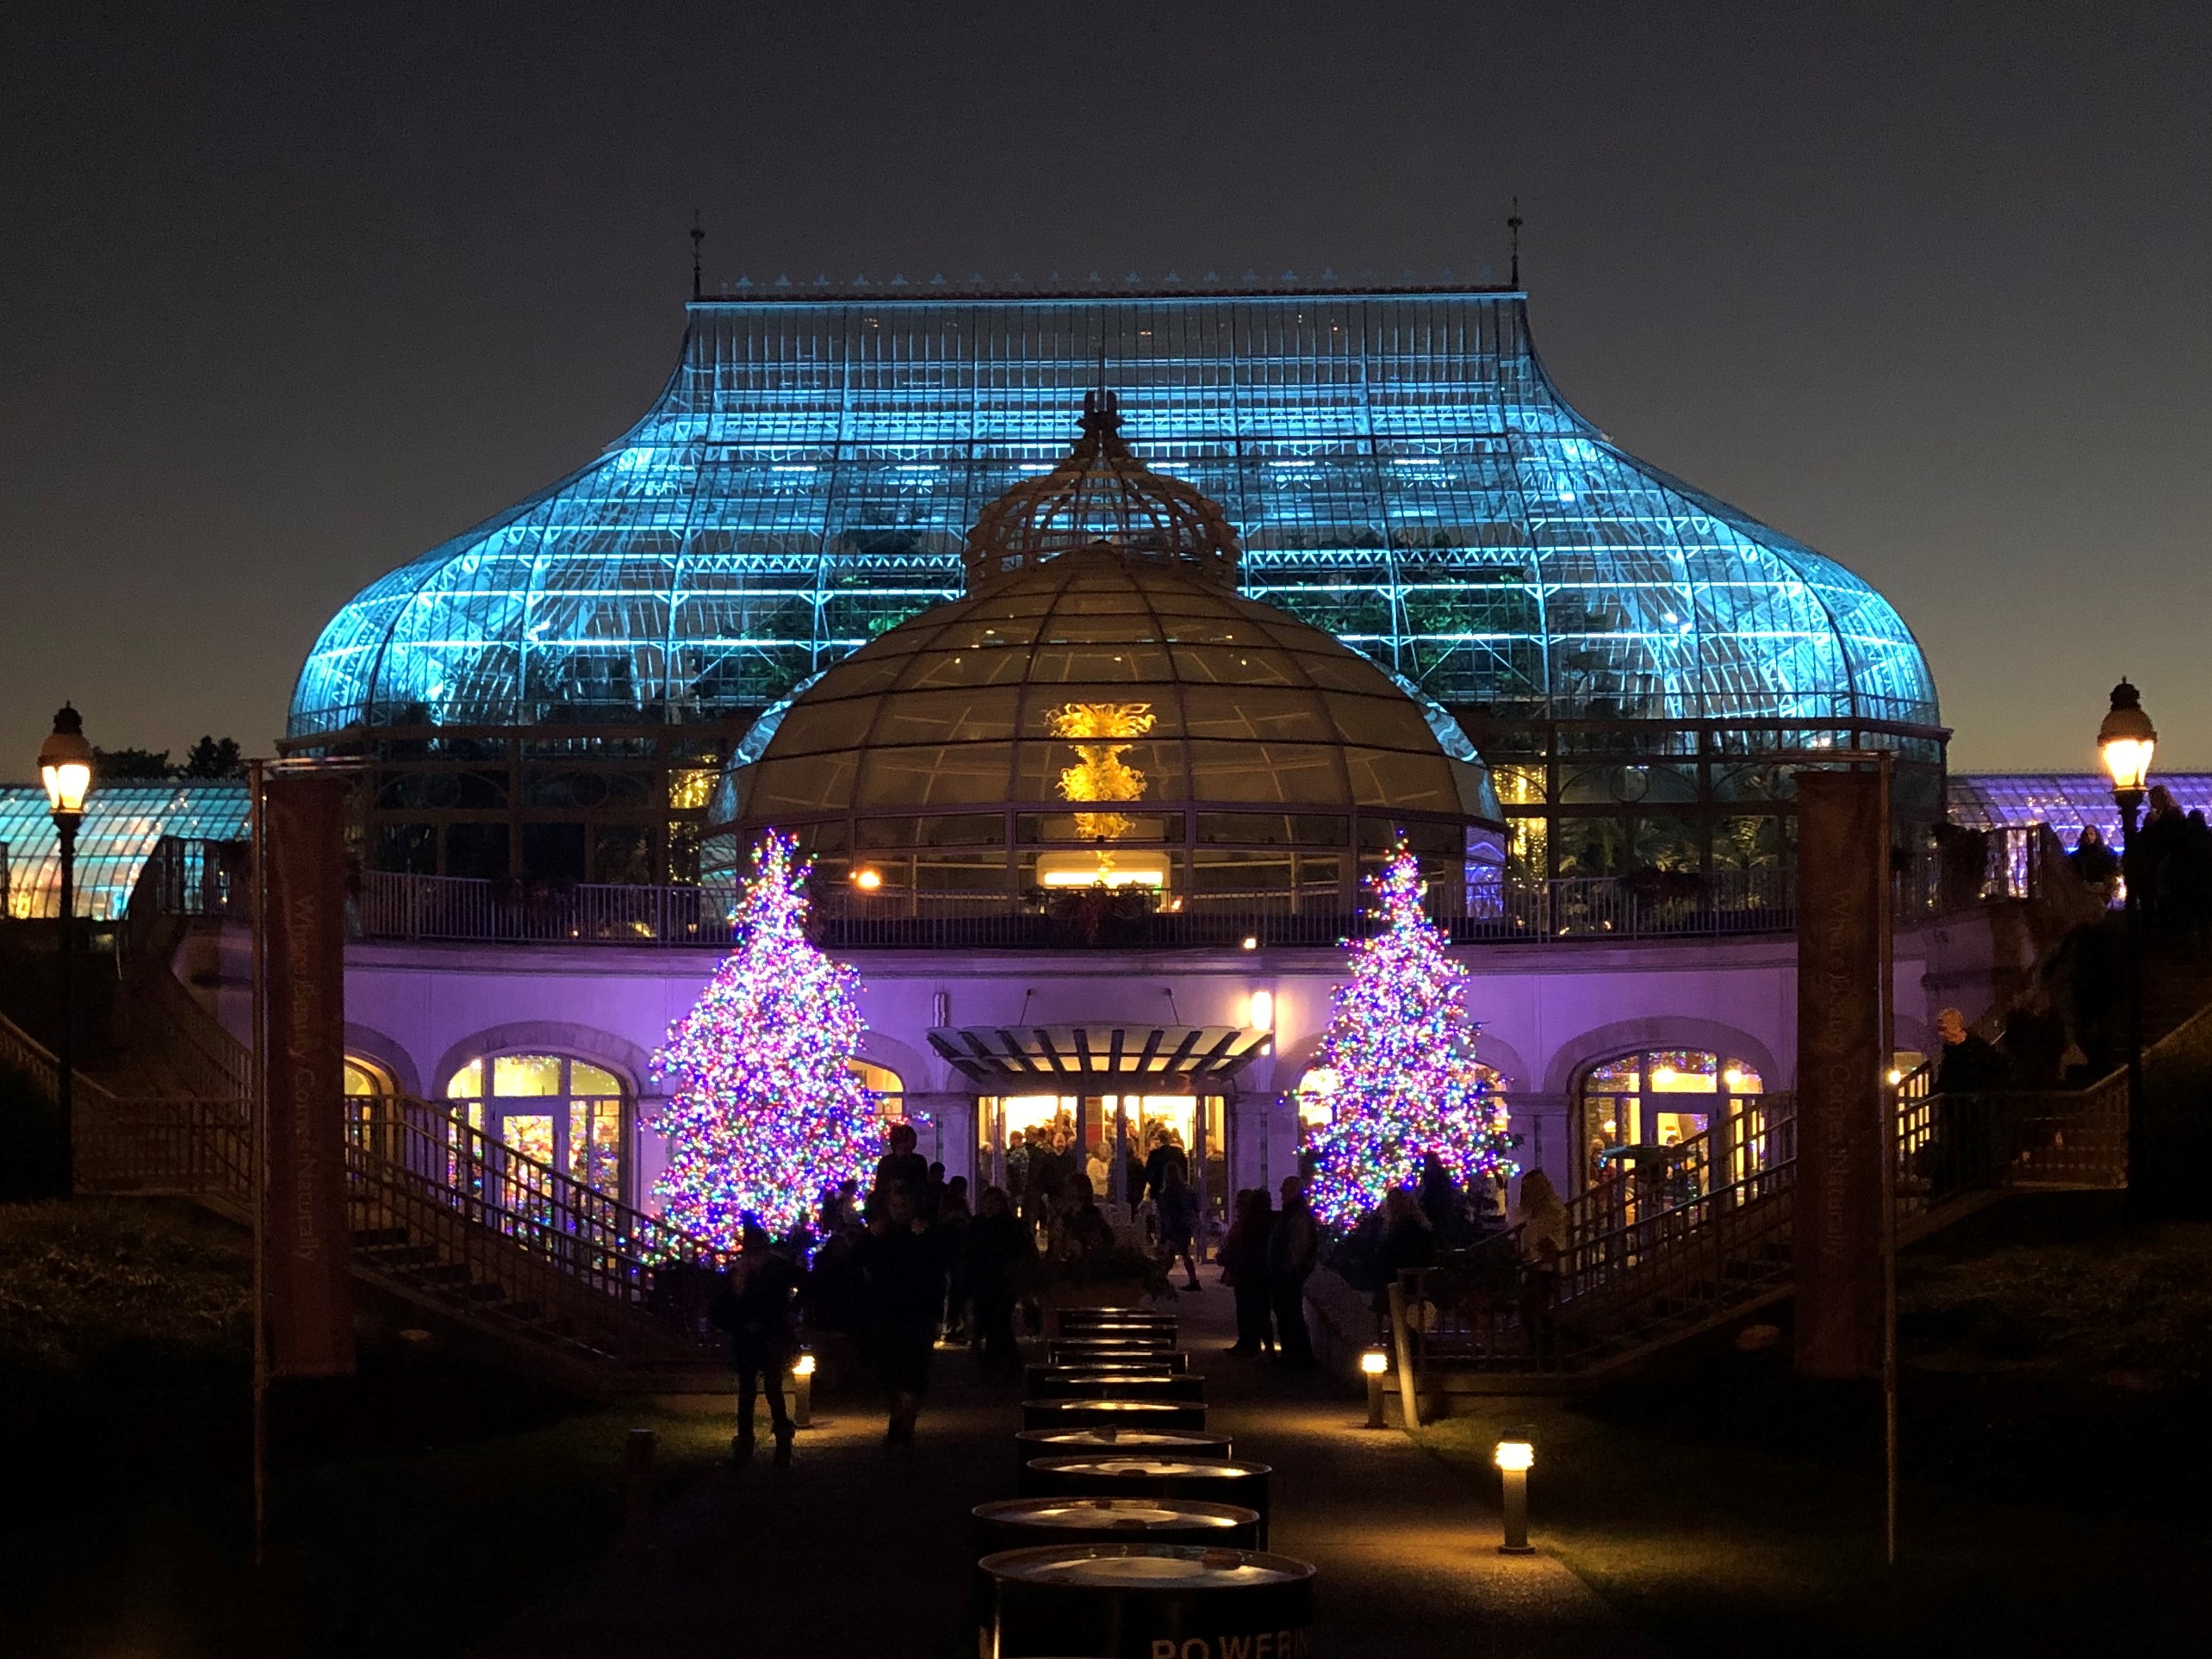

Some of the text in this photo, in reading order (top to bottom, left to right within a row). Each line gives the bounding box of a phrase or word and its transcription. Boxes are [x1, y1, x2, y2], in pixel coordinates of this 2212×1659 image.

[1830, 888, 1853, 970] Where
[289, 894, 320, 1261] Where Beauty Comes Naturally
[1830, 1065, 1852, 1143] Comes
[1823, 1155, 1849, 1258] Naturally
